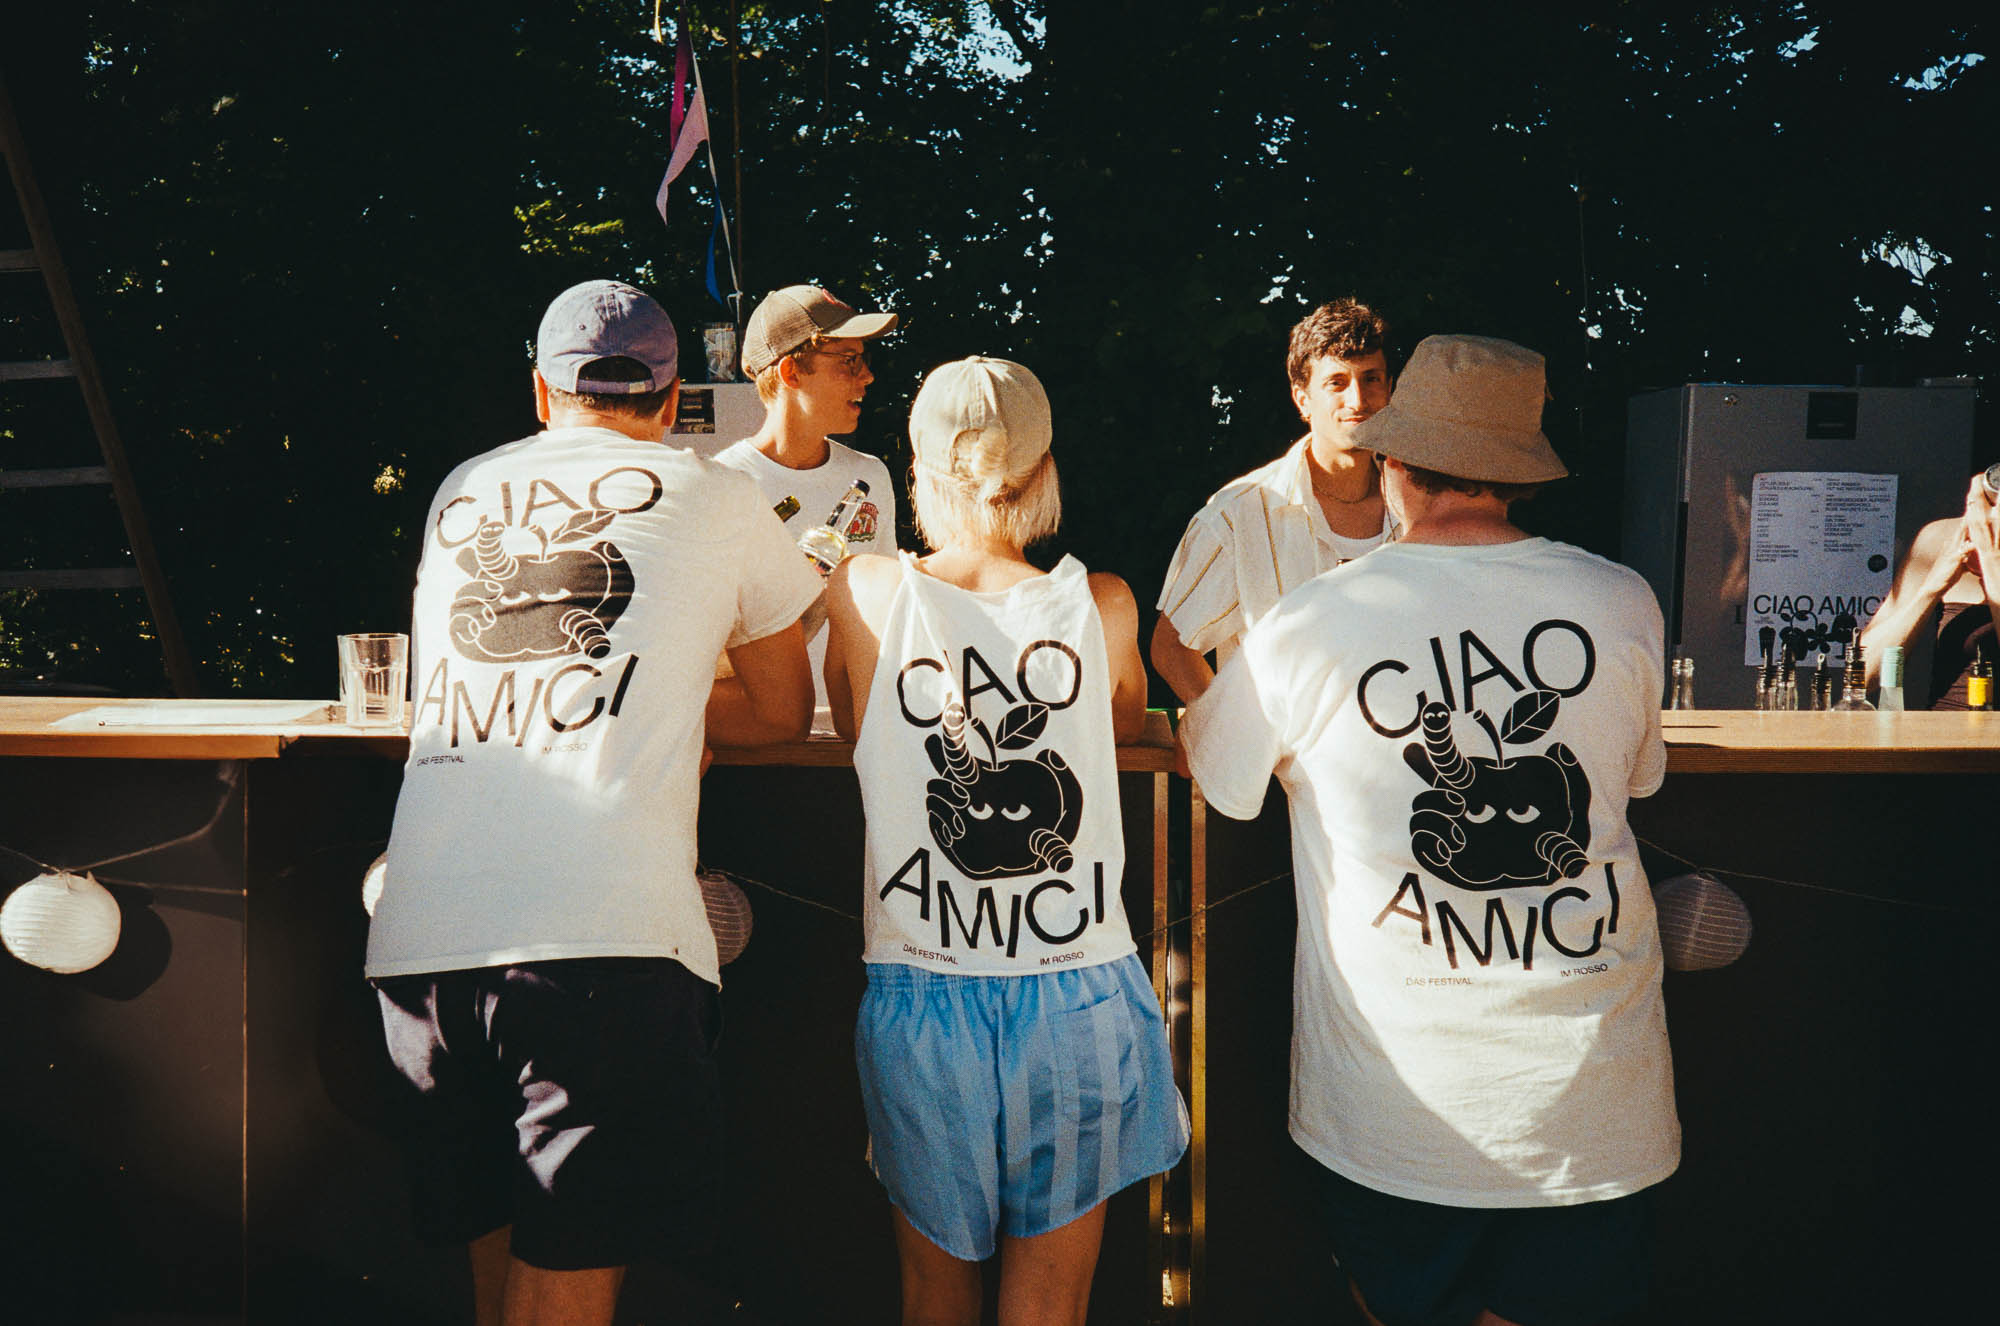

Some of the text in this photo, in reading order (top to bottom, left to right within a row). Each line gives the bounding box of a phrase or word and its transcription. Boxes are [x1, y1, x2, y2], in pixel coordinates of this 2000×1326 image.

[437, 466, 663, 549] CIAO
[1753, 594, 1814, 615] CIAO
[1818, 595, 1886, 616] AMIC
[417, 653, 639, 749] AMICI
[1357, 618, 1596, 739] CIAO
[430, 755, 465, 764] FESTIVAL
[879, 847, 1105, 958] AMICI
[1371, 862, 1620, 971] AMICI
[903, 943, 1085, 966] DAS FESTIVAL IM ROSSO
[1406, 963, 1609, 986] DAS FESTIVAL IM ROSSO
